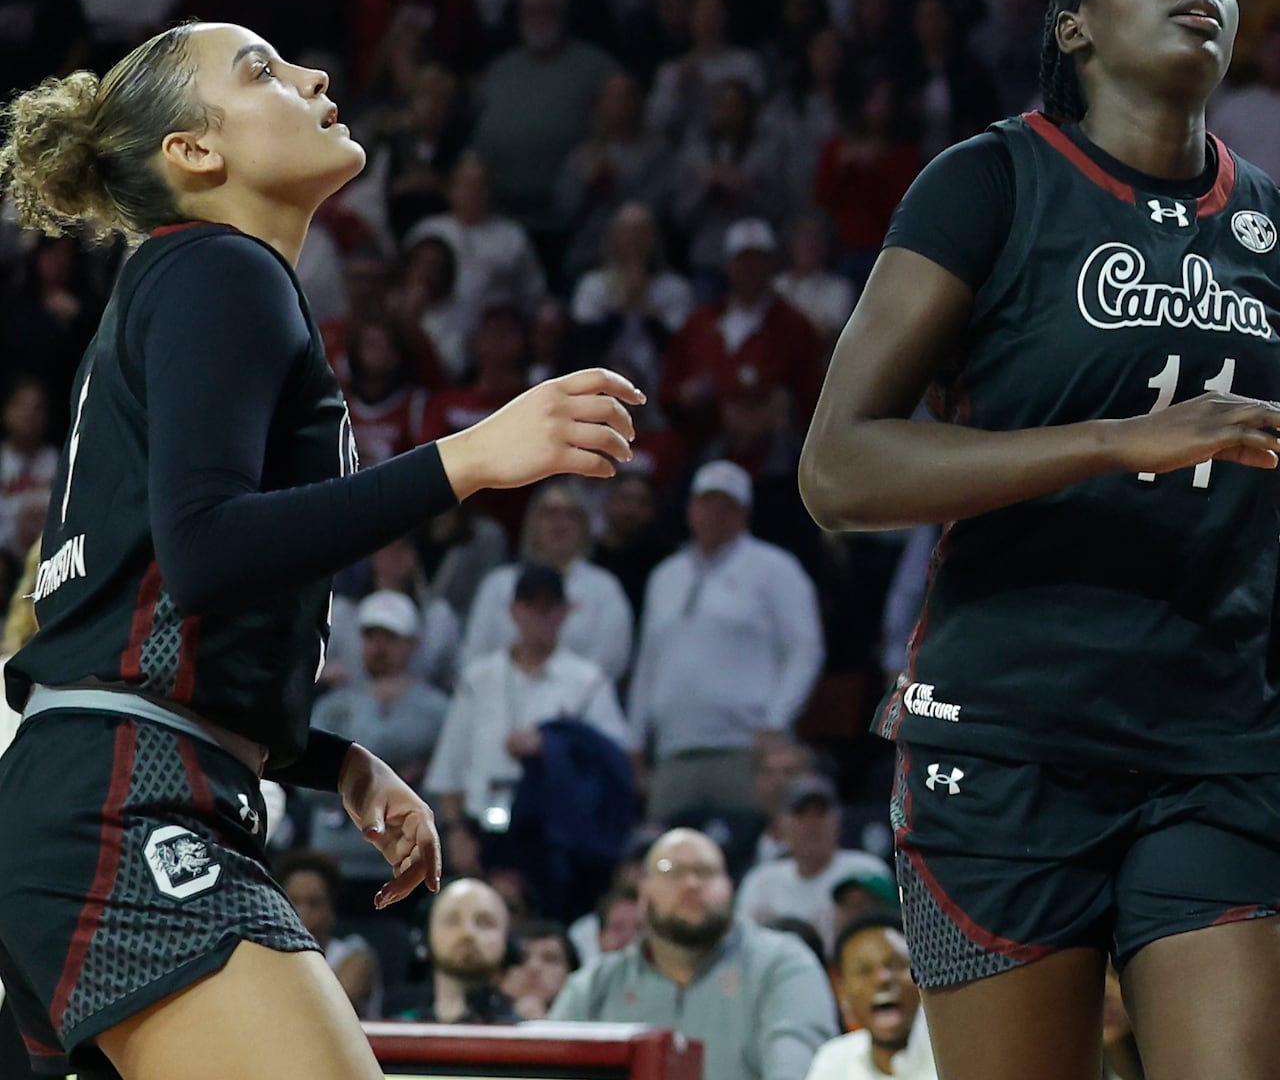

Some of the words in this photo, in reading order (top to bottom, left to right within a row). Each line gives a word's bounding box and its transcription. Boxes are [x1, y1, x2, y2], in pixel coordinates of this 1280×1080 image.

[1235, 214, 1274, 249] SEC
[1077, 242, 1272, 339] Carolina
[916, 683, 935, 701] THE
[912, 699, 961, 722] CULTURE
